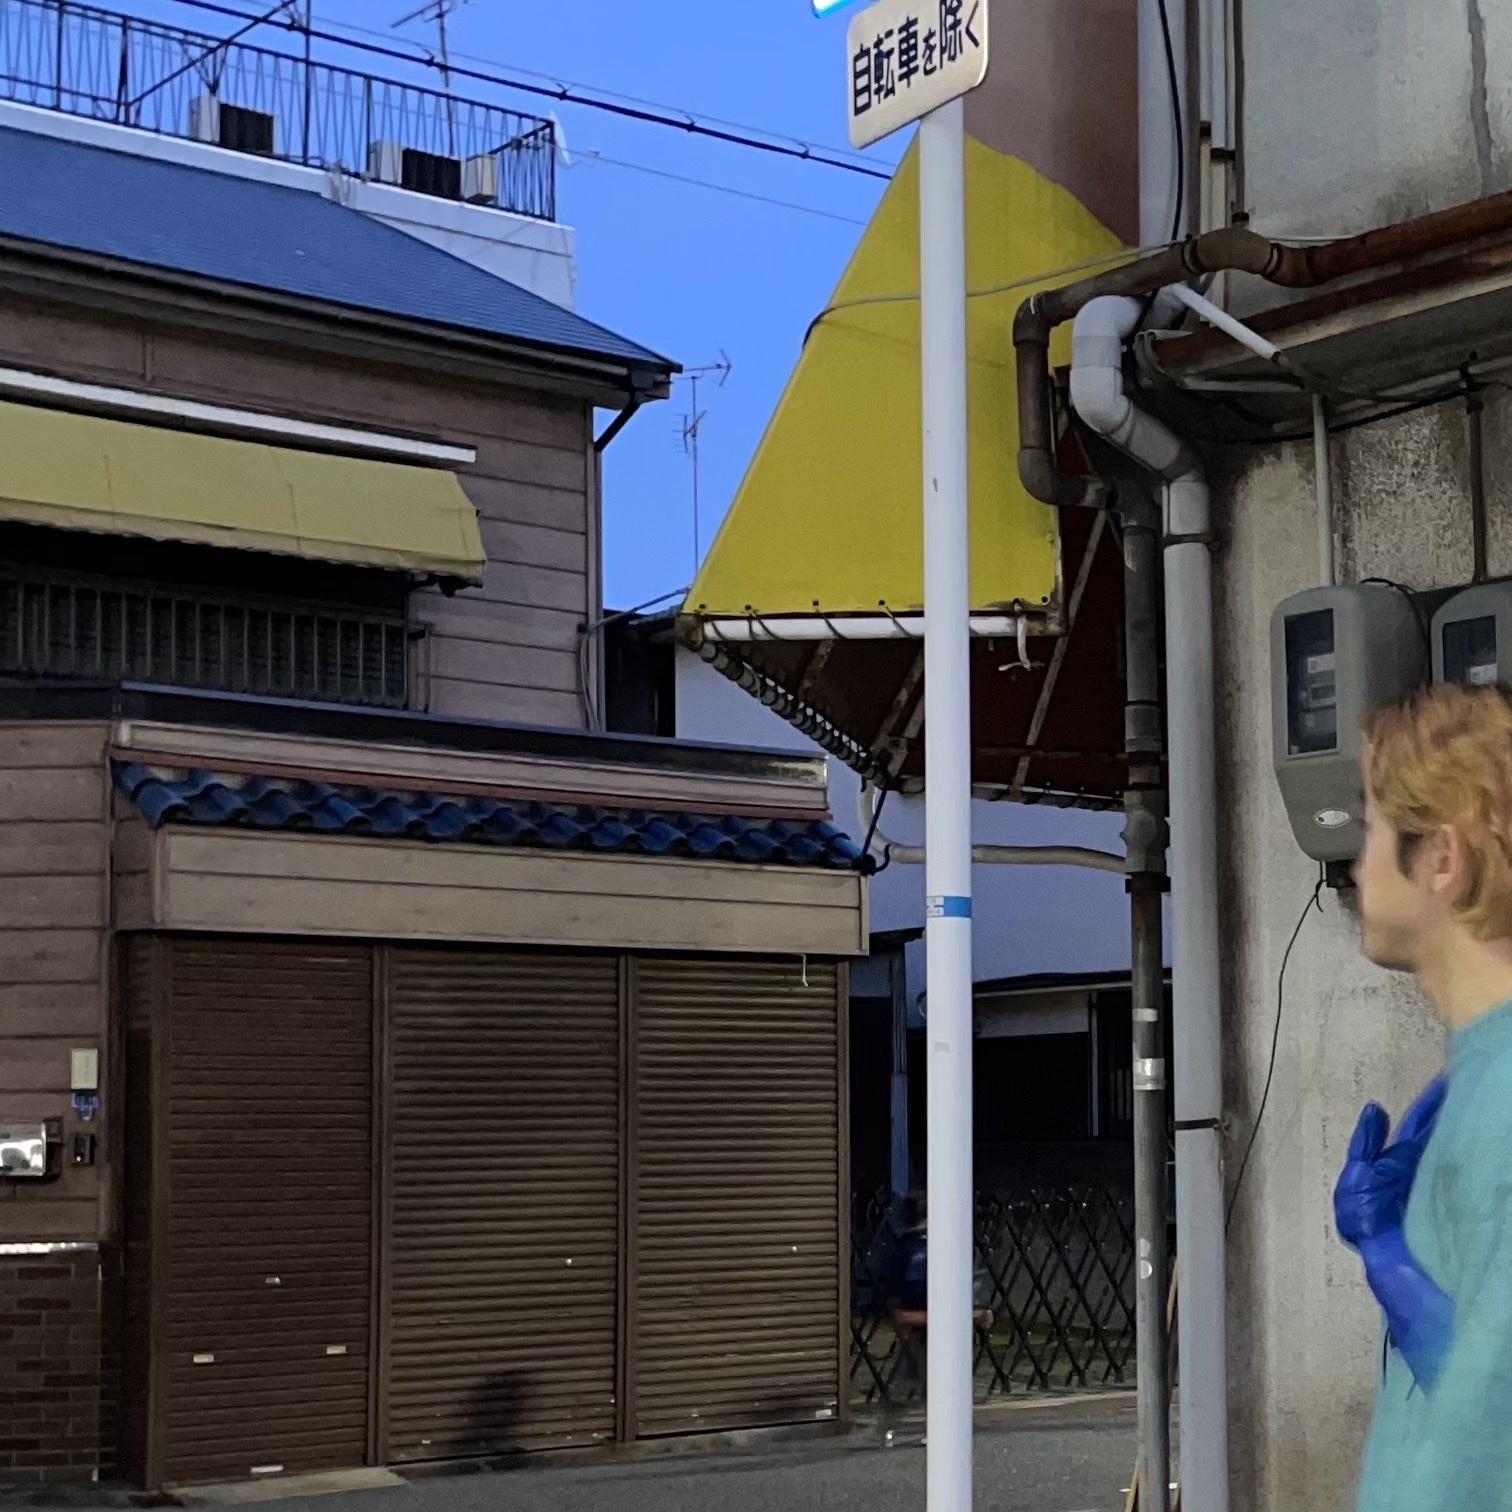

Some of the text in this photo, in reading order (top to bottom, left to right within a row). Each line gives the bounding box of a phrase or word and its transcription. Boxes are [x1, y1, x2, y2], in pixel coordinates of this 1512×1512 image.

[853, 0, 980, 117] 自転車を除く
